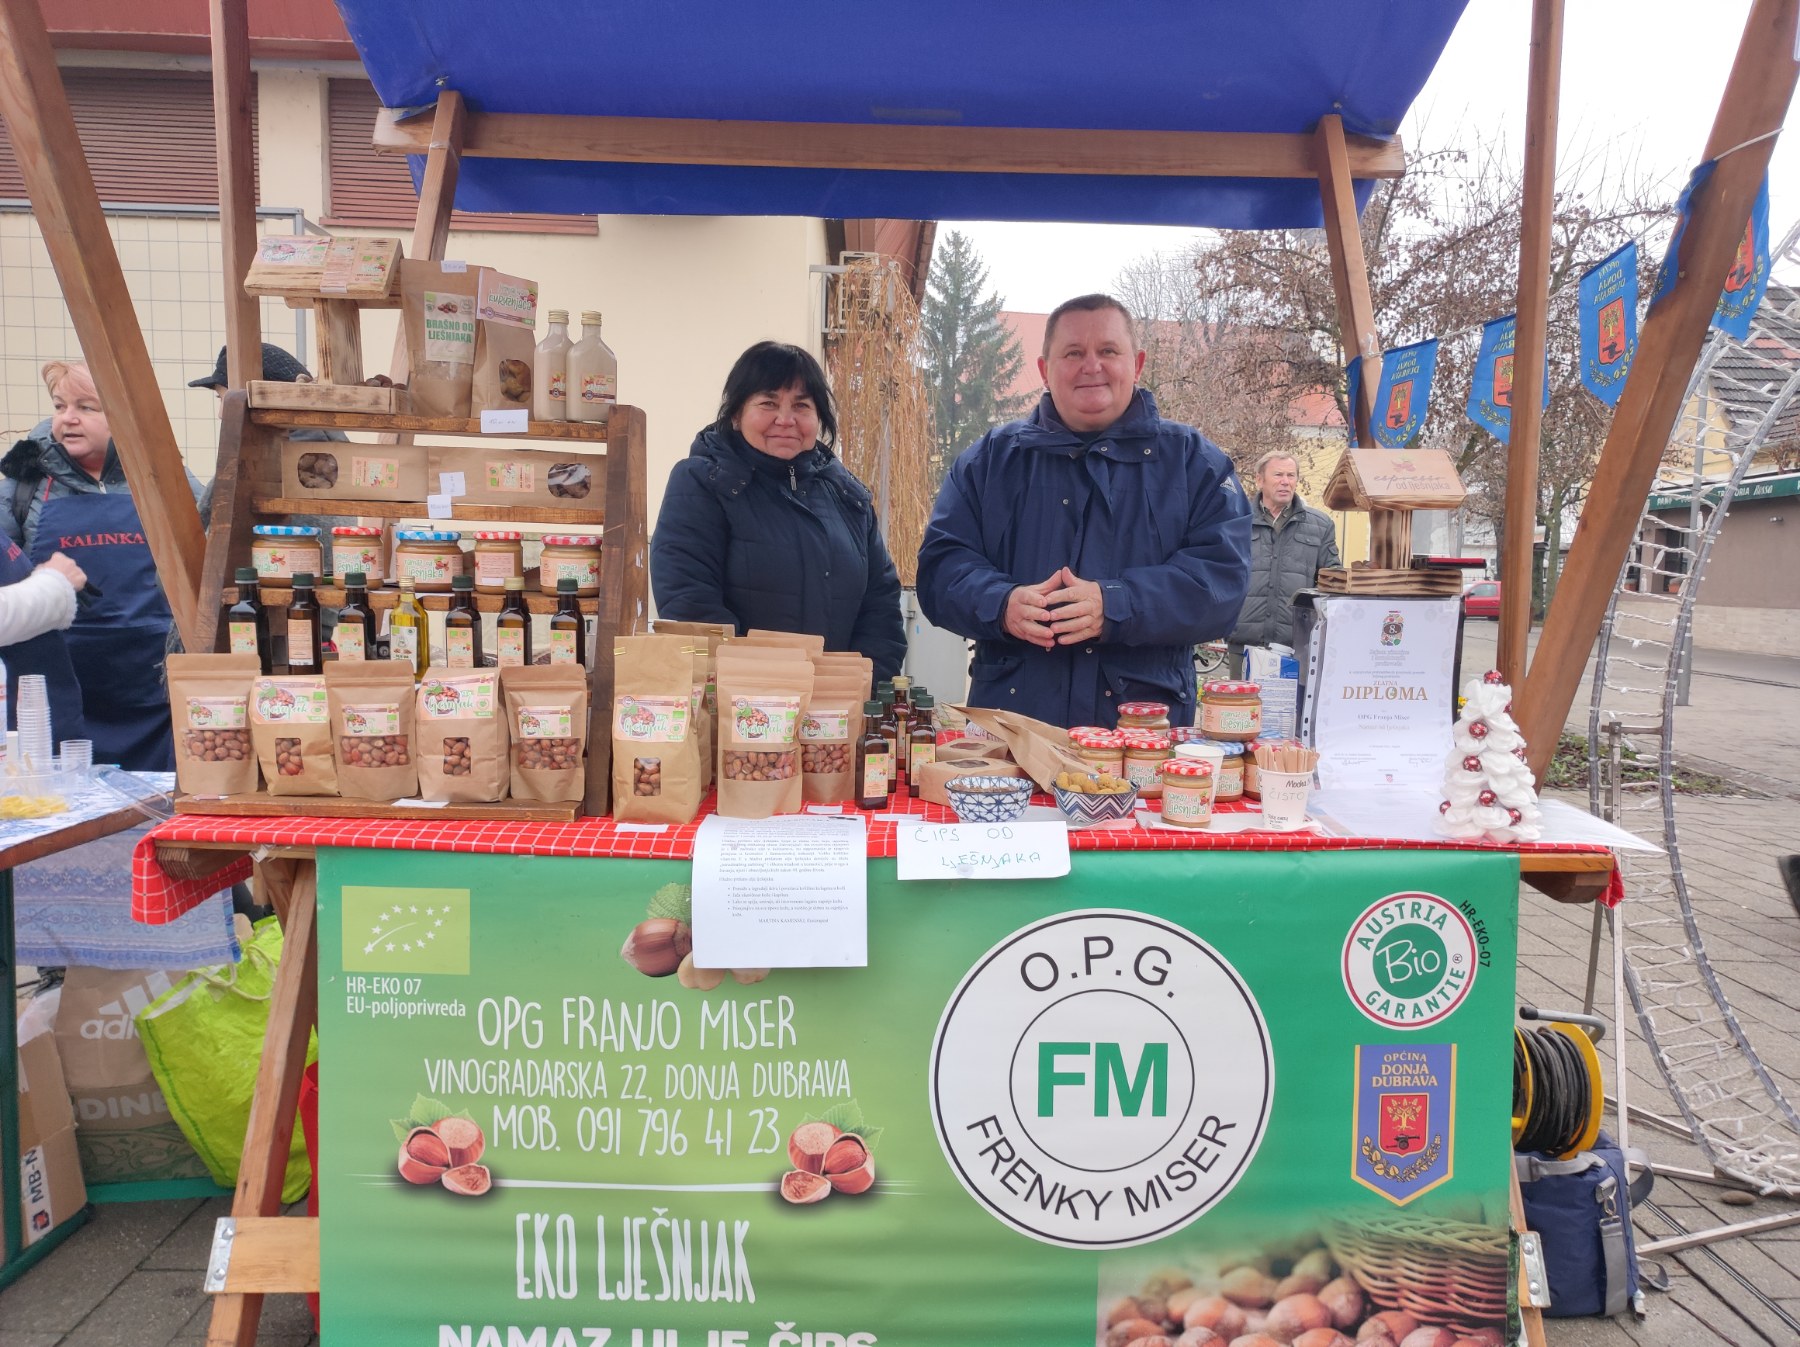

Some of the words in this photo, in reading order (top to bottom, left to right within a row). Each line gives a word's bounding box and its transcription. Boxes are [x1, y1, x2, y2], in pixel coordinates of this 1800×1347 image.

[426, 318, 460, 330] BRAŠNO
[462, 322, 474, 332] OD
[1395, 481, 1407, 490] od
[59, 532, 145, 549] KALINKA
[1342, 686, 1429, 701] DIPLOMA
[1268, 787, 1305, 801] ČISTO
[914, 826, 960, 843] ČIPS
[986, 826, 1014, 840] OD
[941, 850, 1041, 869] LJEŠNJAKA
[1357, 901, 1448, 951] AUSTRIA
[1459, 900, 1491, 968] HR-EKO-07
[1020, 935, 1174, 998] O.P.G.
[1376, 939, 1440, 984] Bio
[346, 976, 400, 994] HR-EKO
[403, 978, 422, 995] 07
[1365, 966, 1466, 1019] GARANTIE
[346, 996, 467, 1019] EU-poljoprivreda
[477, 996, 544, 1051] OPG
[562, 995, 682, 1053] FRANJO
[700, 995, 797, 1051] MISER
[1383, 1050, 1427, 1062] OPĆINA
[424, 1058, 608, 1100] VINOGRADARSKA
[620, 1065, 653, 1105] 22,
[664, 1061, 741, 1101] DONJA
[752, 1058, 852, 1099] DUBRAVA
[1037, 1041, 1169, 1118] FM
[1371, 1075, 1439, 1088] DUBRAVA
[1381, 1064, 1430, 1076] DONJA
[493, 1104, 561, 1152] MOB.
[576, 1106, 622, 1155] 091
[637, 1107, 689, 1157] 796
[704, 1107, 733, 1156] 41
[747, 1106, 782, 1155] 23
[966, 1114, 1113, 1221] FRENKY
[1124, 1115, 1237, 1217] MISER
[515, 1212, 579, 1301] EKO
[597, 1207, 757, 1304] LJEŠNJAK
